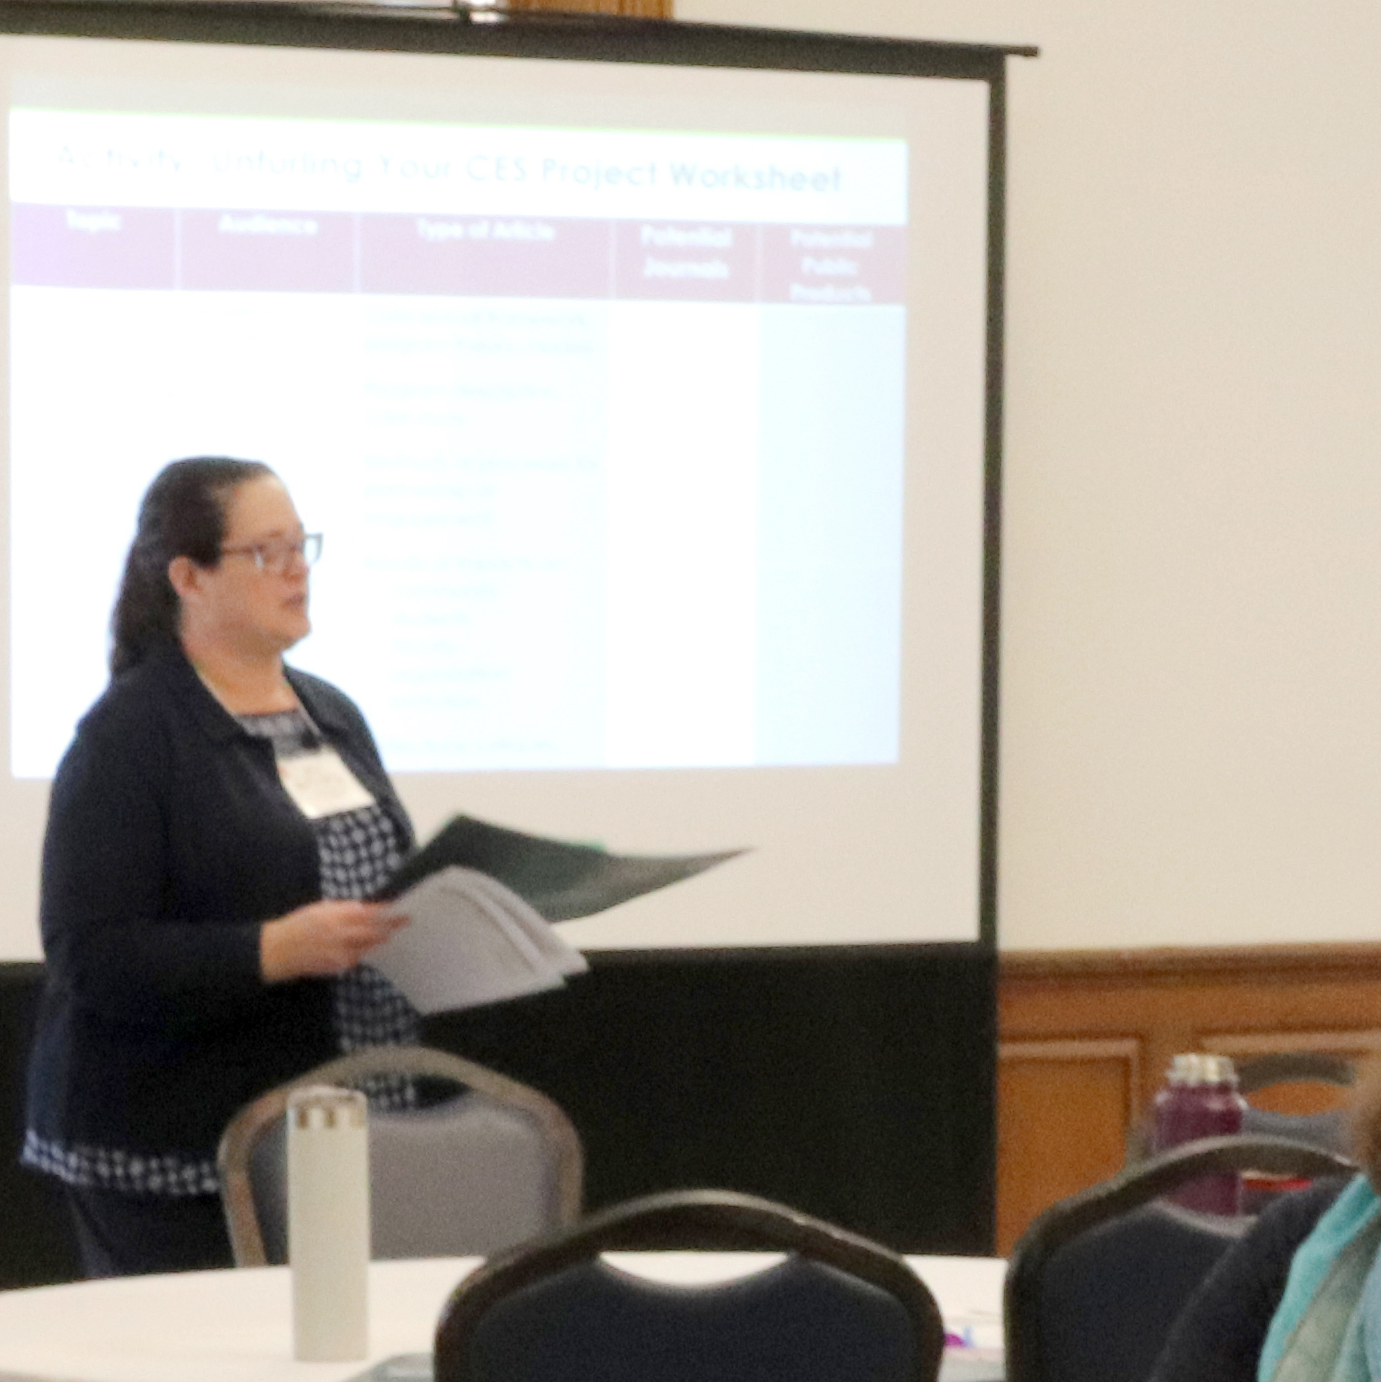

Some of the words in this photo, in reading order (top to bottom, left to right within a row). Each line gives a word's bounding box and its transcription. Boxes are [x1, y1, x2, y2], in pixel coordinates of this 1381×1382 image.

[379, 154, 452, 180] Your
[466, 153, 528, 182] CES
[542, 157, 659, 190] Project
[669, 160, 843, 193] Worksheet
[217, 213, 320, 237] Audience
[416, 217, 464, 243] Type
[468, 220, 490, 240] of
[493, 221, 556, 242] Article
[640, 224, 733, 248] Potential
[643, 256, 730, 279] Journals
